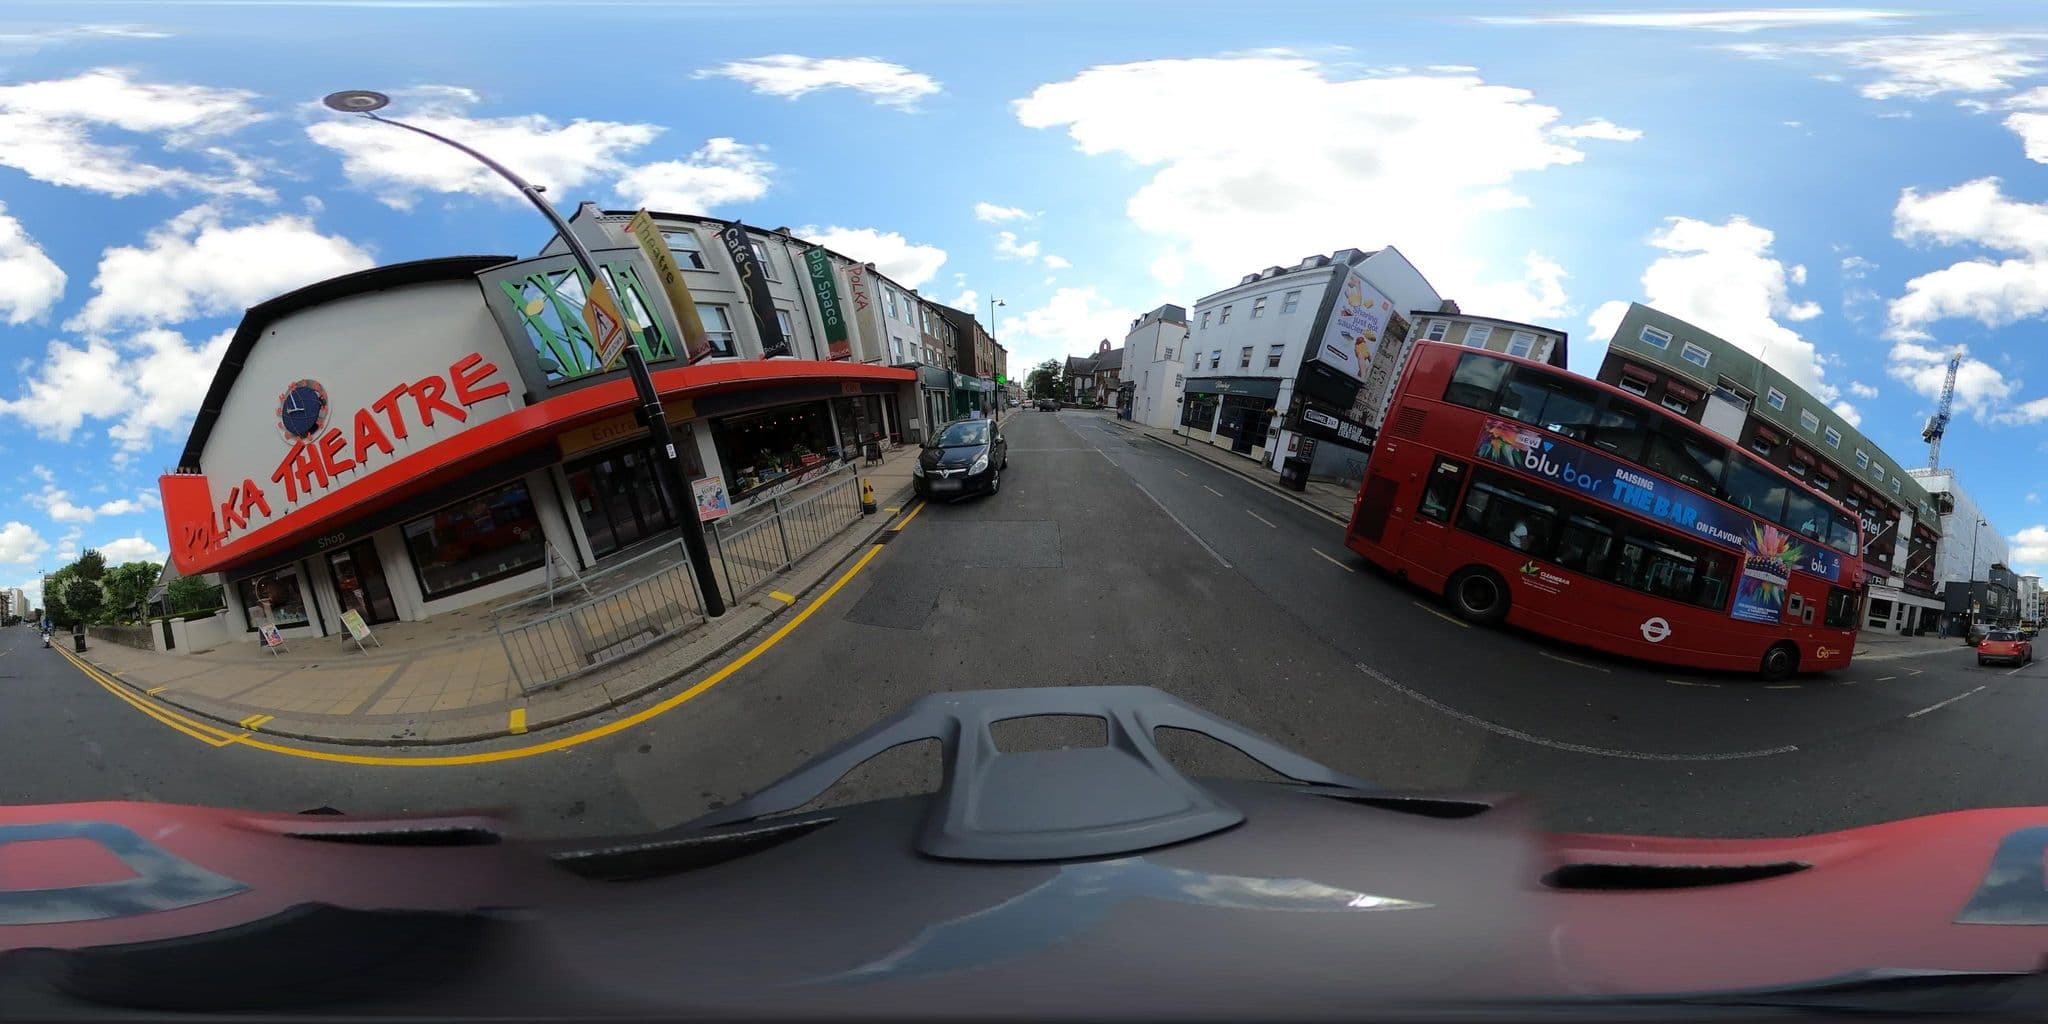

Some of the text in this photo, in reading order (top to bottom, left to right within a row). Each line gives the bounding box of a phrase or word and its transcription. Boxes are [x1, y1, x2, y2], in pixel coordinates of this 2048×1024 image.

[636, 215, 674, 285] Theatre
[725, 228, 750, 264] Café
[808, 248, 838, 326] Play Space
[848, 266, 869, 312] POLKA
[592, 422, 640, 442] Entra
[182, 352, 510, 562] POLKA THEATRE
[1615, 468, 1655, 491] RAISING
[1612, 478, 1698, 528] THE BAR
[318, 532, 345, 549] Shop
[1696, 521, 1743, 546] ON FLAVOUR
[1861, 518, 1881, 535] otel
